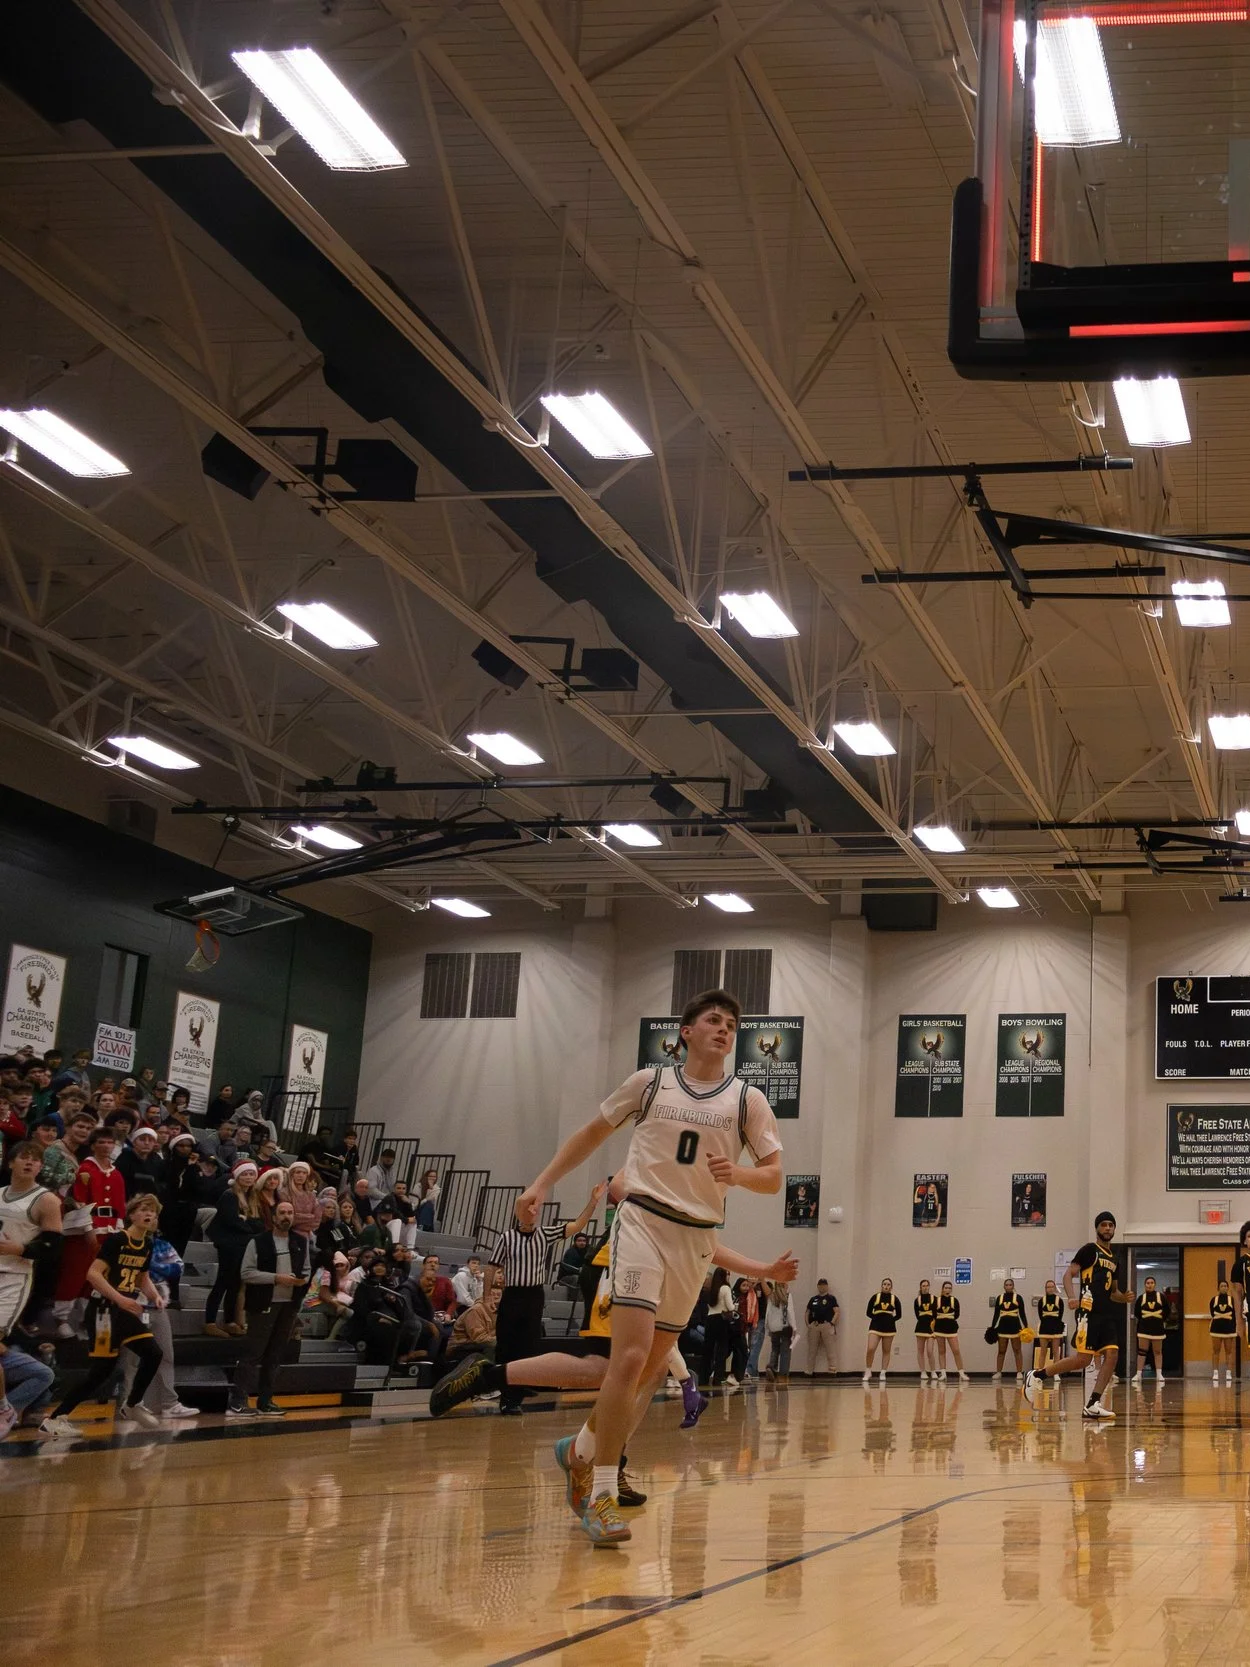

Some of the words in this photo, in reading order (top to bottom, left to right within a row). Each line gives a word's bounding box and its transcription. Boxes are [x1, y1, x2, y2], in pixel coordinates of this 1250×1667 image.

[1170, 1003, 1199, 1014] HOME
[6, 1011, 54, 1033] CHAMPIONS
[20, 1022, 40, 1032] 2015
[650, 1022, 680, 1030] BASEB
[741, 1022, 759, 1031] BOYS'
[760, 1021, 802, 1031] BASKETBALL
[923, 1019, 964, 1027] BASKETBALL
[11, 1030, 46, 1043] BASEBALL
[99, 1027, 112, 1037] FM
[114, 1031, 133, 1041] 101.7
[97, 1039, 131, 1058] KLWN
[1165, 1040, 1187, 1048] FOULS
[1194, 1040, 1213, 1048] T.O.L.
[1220, 1040, 1246, 1048] PLAYER
[95, 1056, 110, 1066] AM
[174, 1050, 211, 1069] CHAMPIONS
[1164, 1068, 1187, 1076] SCORE
[655, 1104, 733, 1131] FIREBIRDS
[1198, 1118, 1217, 1129] FREE
[1219, 1118, 1242, 1129] STATE
[1196, 1133, 1207, 1141] THEE
[1208, 1133, 1232, 1141] LAWRENCE
[1233, 1133, 1244, 1141] FREE
[677, 1130, 700, 1165] 0
[1192, 1144, 1212, 1153] COURAGE
[1234, 1144, 1249, 1153] HONOR
[1202, 1167, 1226, 1175] LAWRENCE
[1227, 1167, 1237, 1175] FREE
[1104, 1270, 1113, 1291] 3
